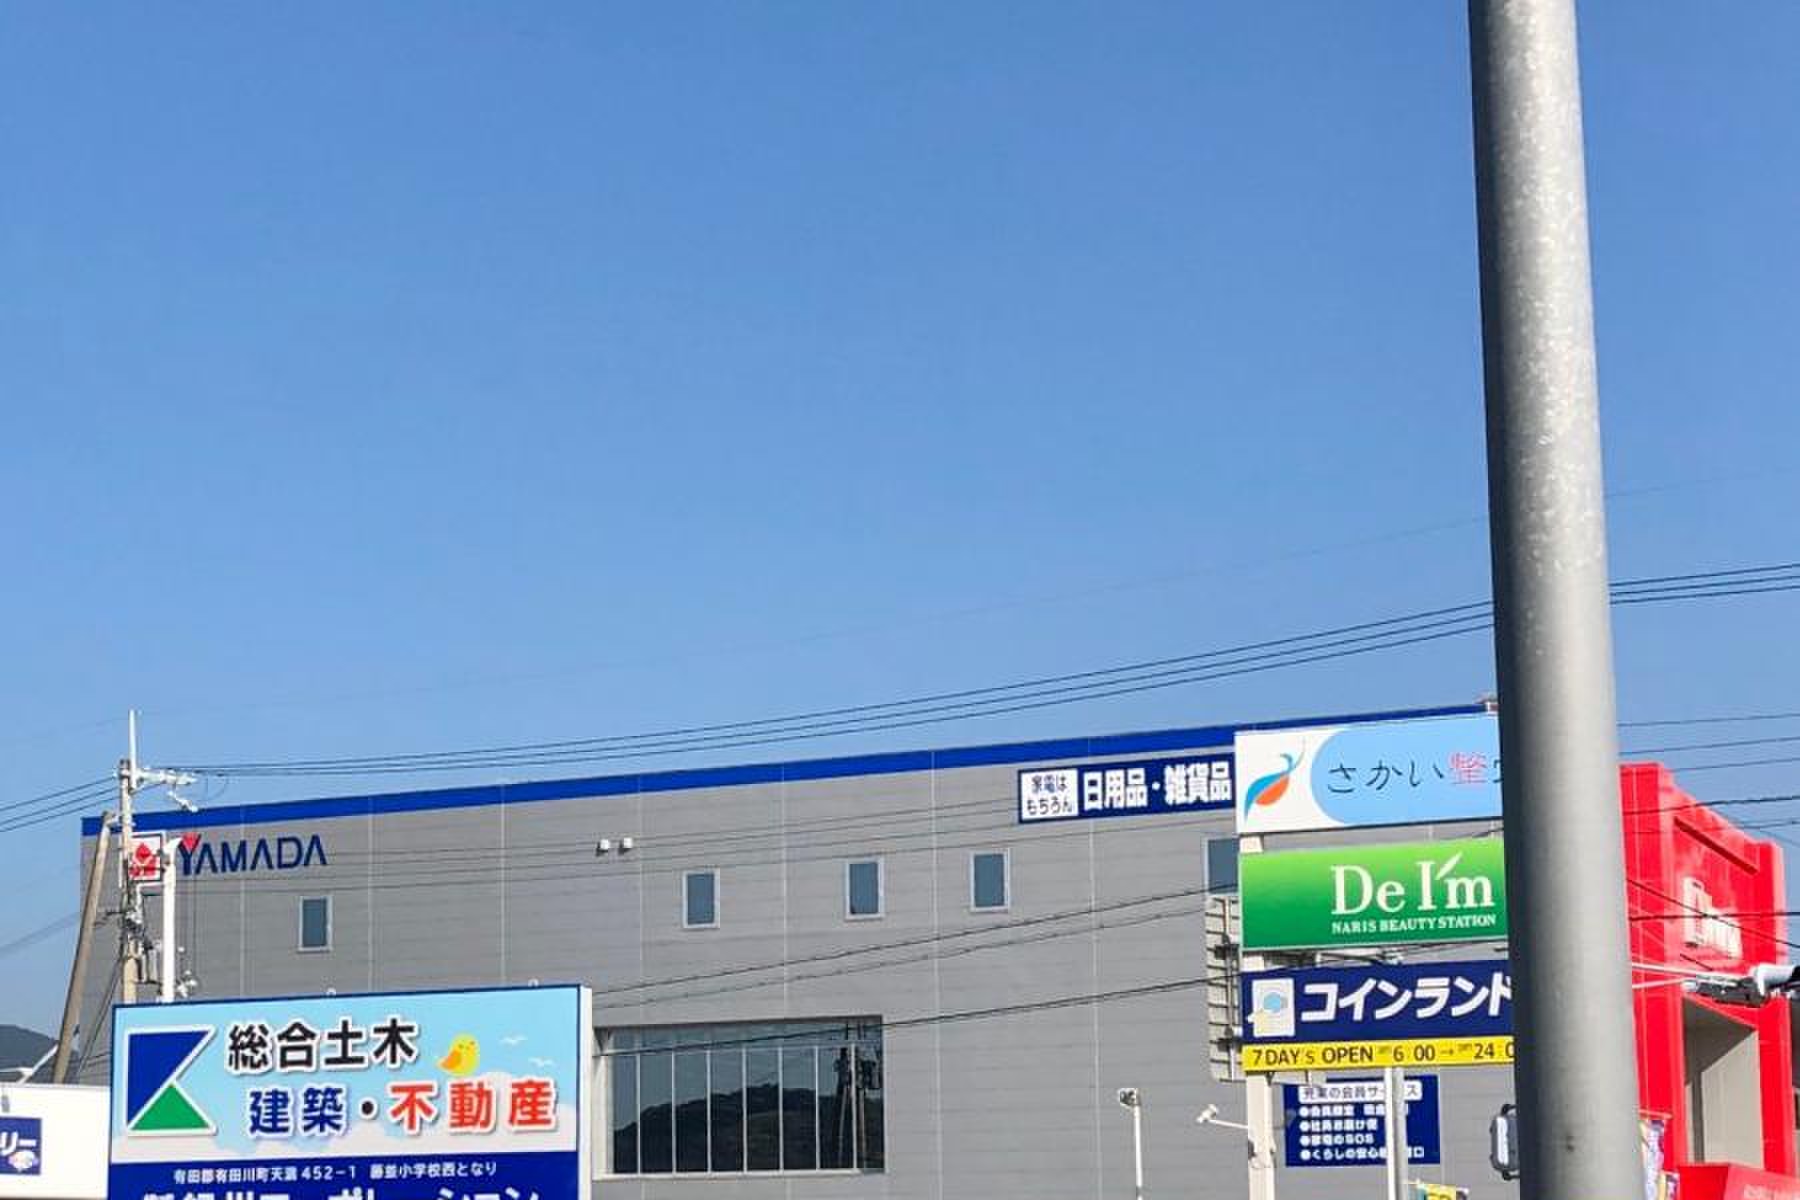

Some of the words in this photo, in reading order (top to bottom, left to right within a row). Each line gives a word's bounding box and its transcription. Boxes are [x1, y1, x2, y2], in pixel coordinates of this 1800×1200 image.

[1327, 752, 1503, 794] さかい整
[178, 832, 327, 876] YAMADA
[1330, 864, 1406, 916] De
[1331, 921, 1377, 935] NARIS
[1379, 917, 1437, 933] BEAUTY
[1438, 914, 1497, 929] STATION
[1301, 971, 1512, 1022] コインランド
[227, 1017, 417, 1071] 総合土木
[1321, 1045, 1374, 1064] OPEN
[248, 1079, 552, 1135] 建築・不動産
